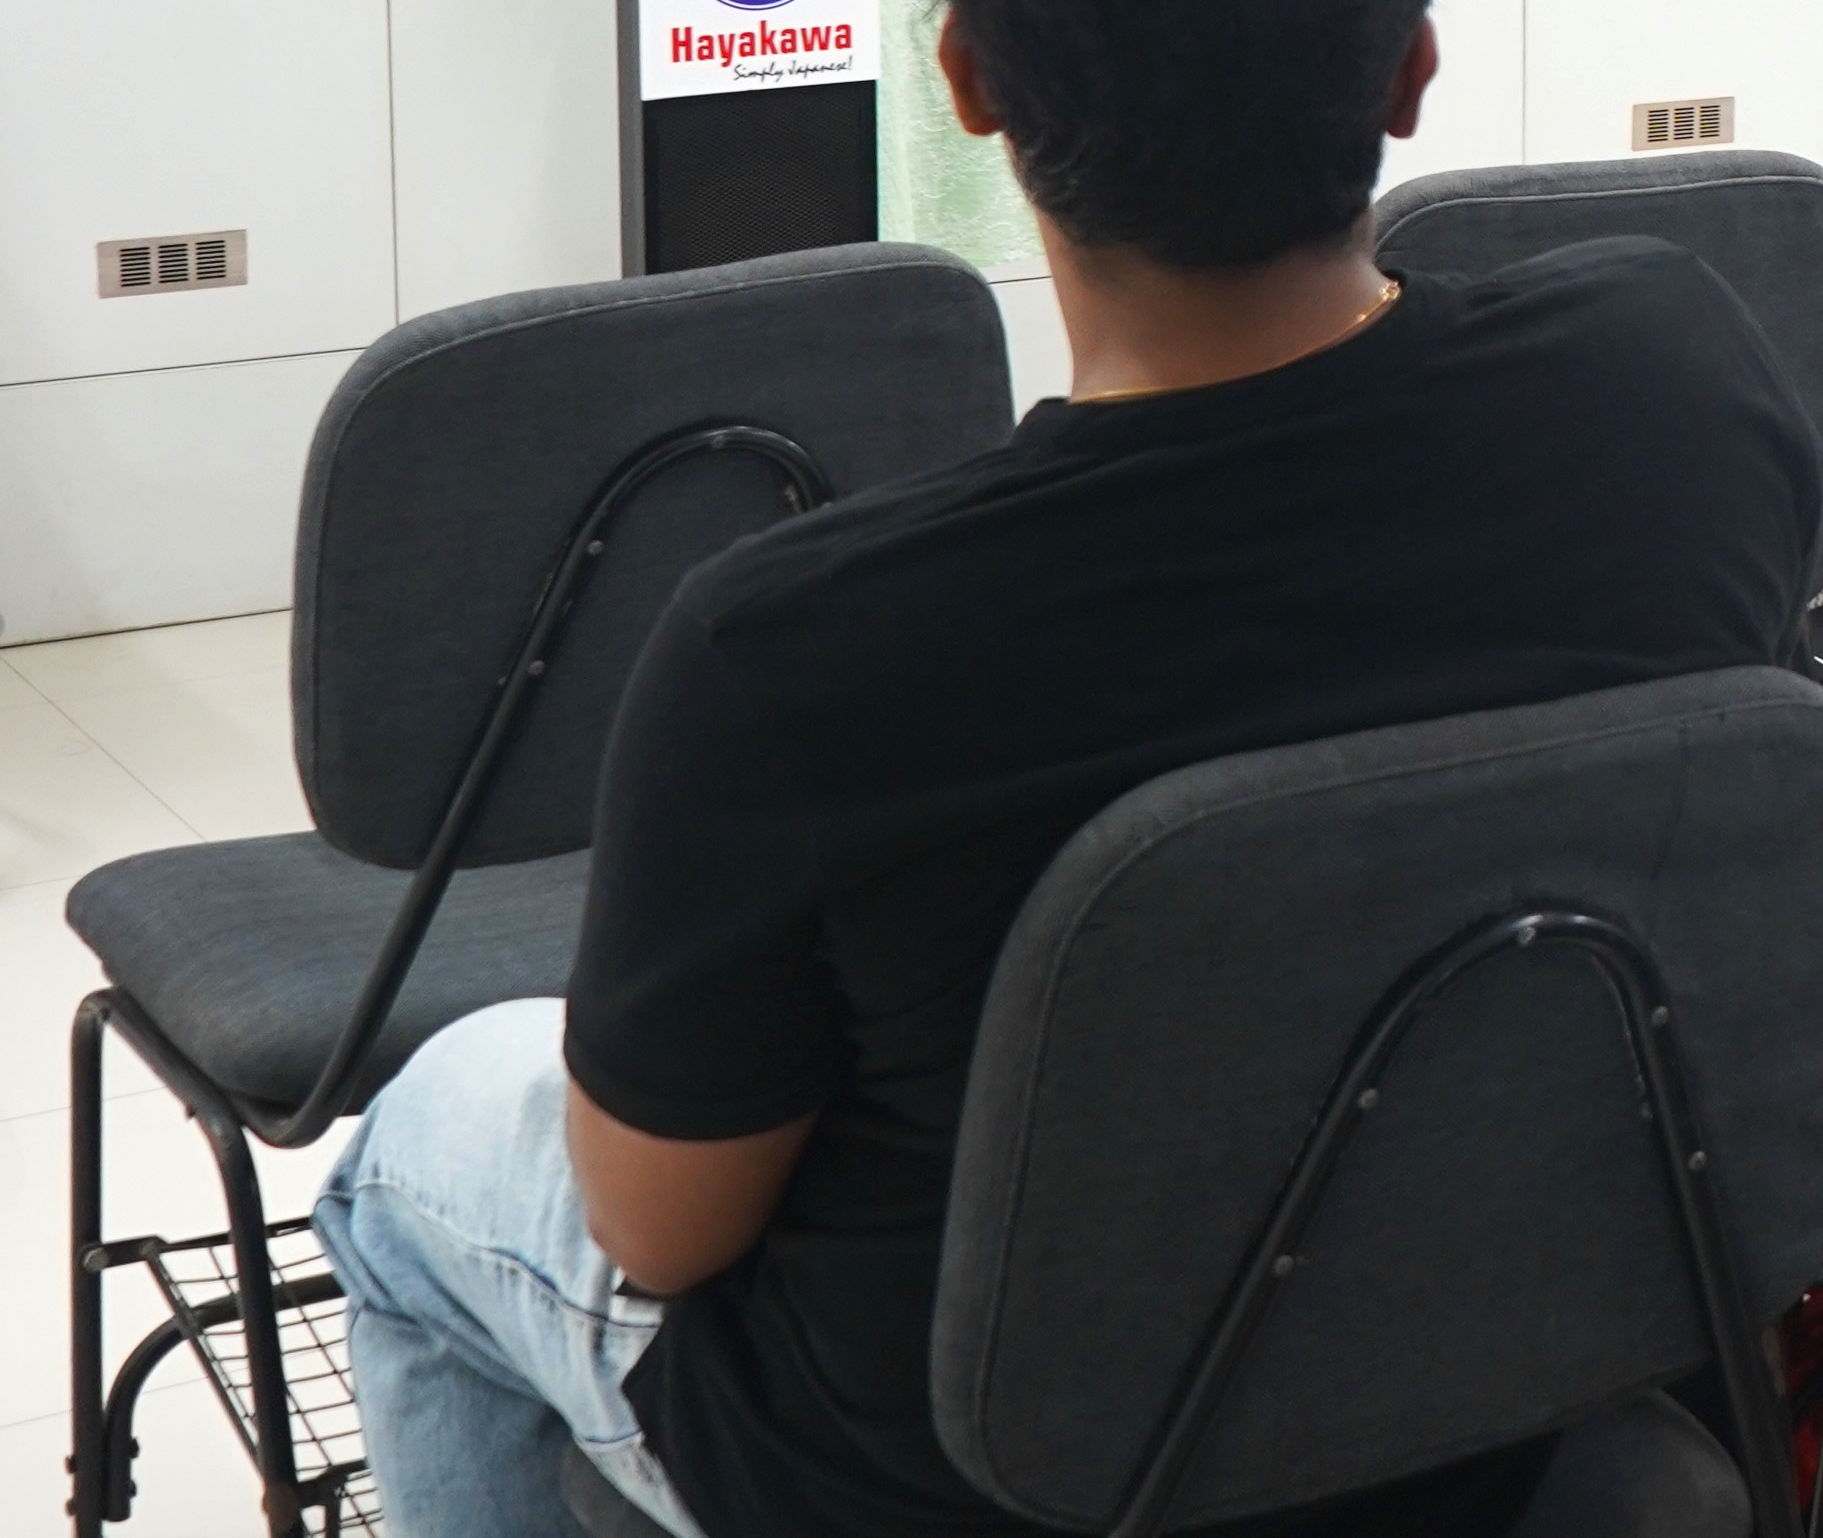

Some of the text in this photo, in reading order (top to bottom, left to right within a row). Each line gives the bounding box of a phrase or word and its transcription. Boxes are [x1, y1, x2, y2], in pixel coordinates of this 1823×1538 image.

[671, 20, 853, 67] Hayakawa
[733, 56, 854, 82] Simply Japanese!
